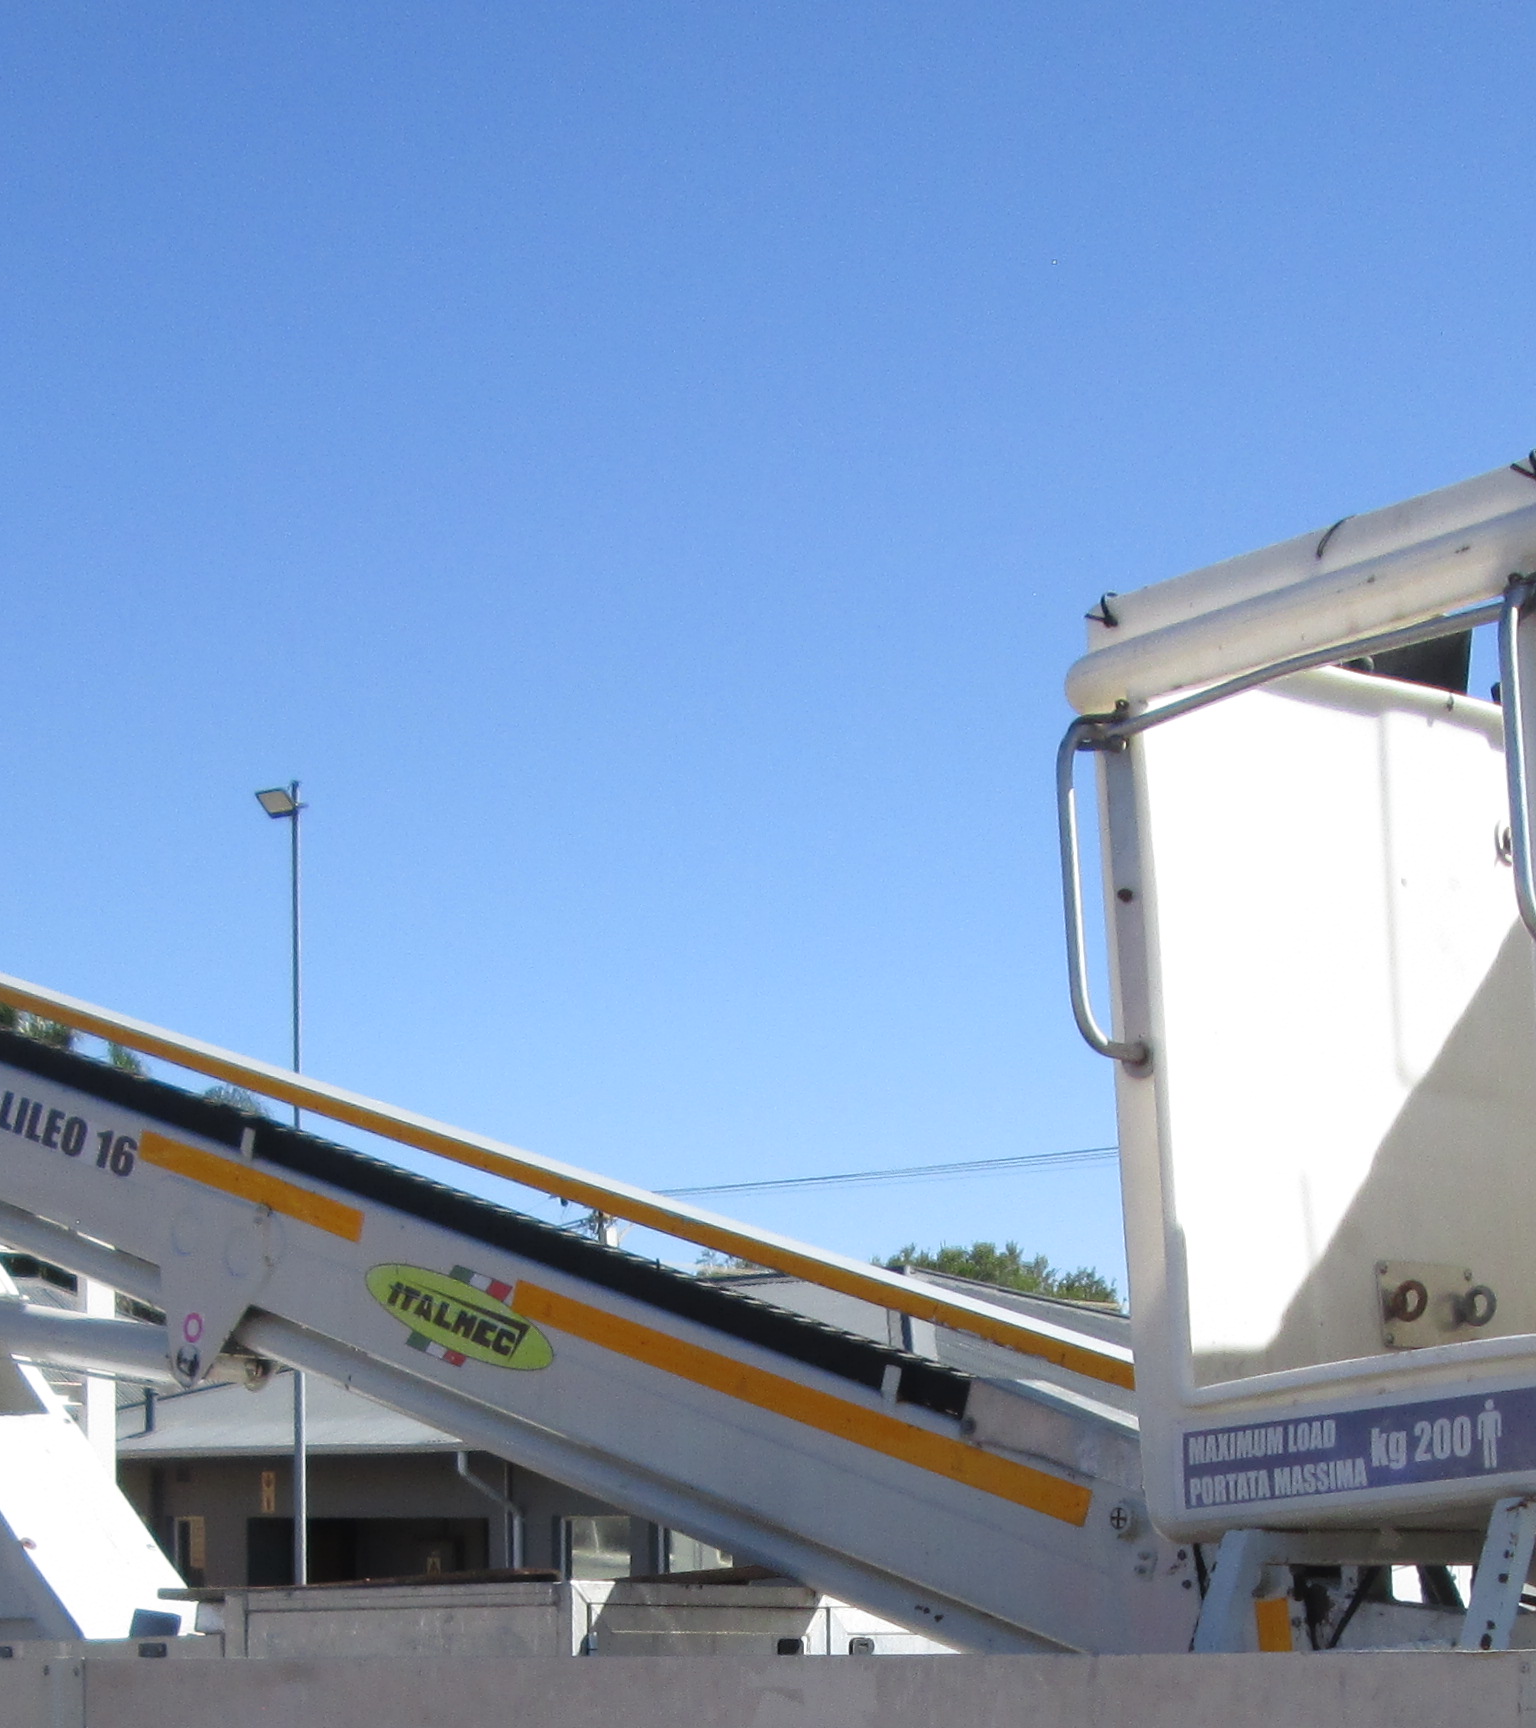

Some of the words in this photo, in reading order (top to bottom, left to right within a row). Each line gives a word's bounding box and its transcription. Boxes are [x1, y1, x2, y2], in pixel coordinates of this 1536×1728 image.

[95, 1129, 138, 1177] 16
[387, 1281, 517, 1357] ITALMEC
[1188, 1426, 1284, 1466] MAXIMUM
[1287, 1419, 1337, 1454] LOAD
[1370, 1426, 1407, 1470] kg
[1413, 1416, 1472, 1463] 200
[1189, 1472, 1271, 1506] PORTATA
[1273, 1457, 1369, 1498] MASSIMA
